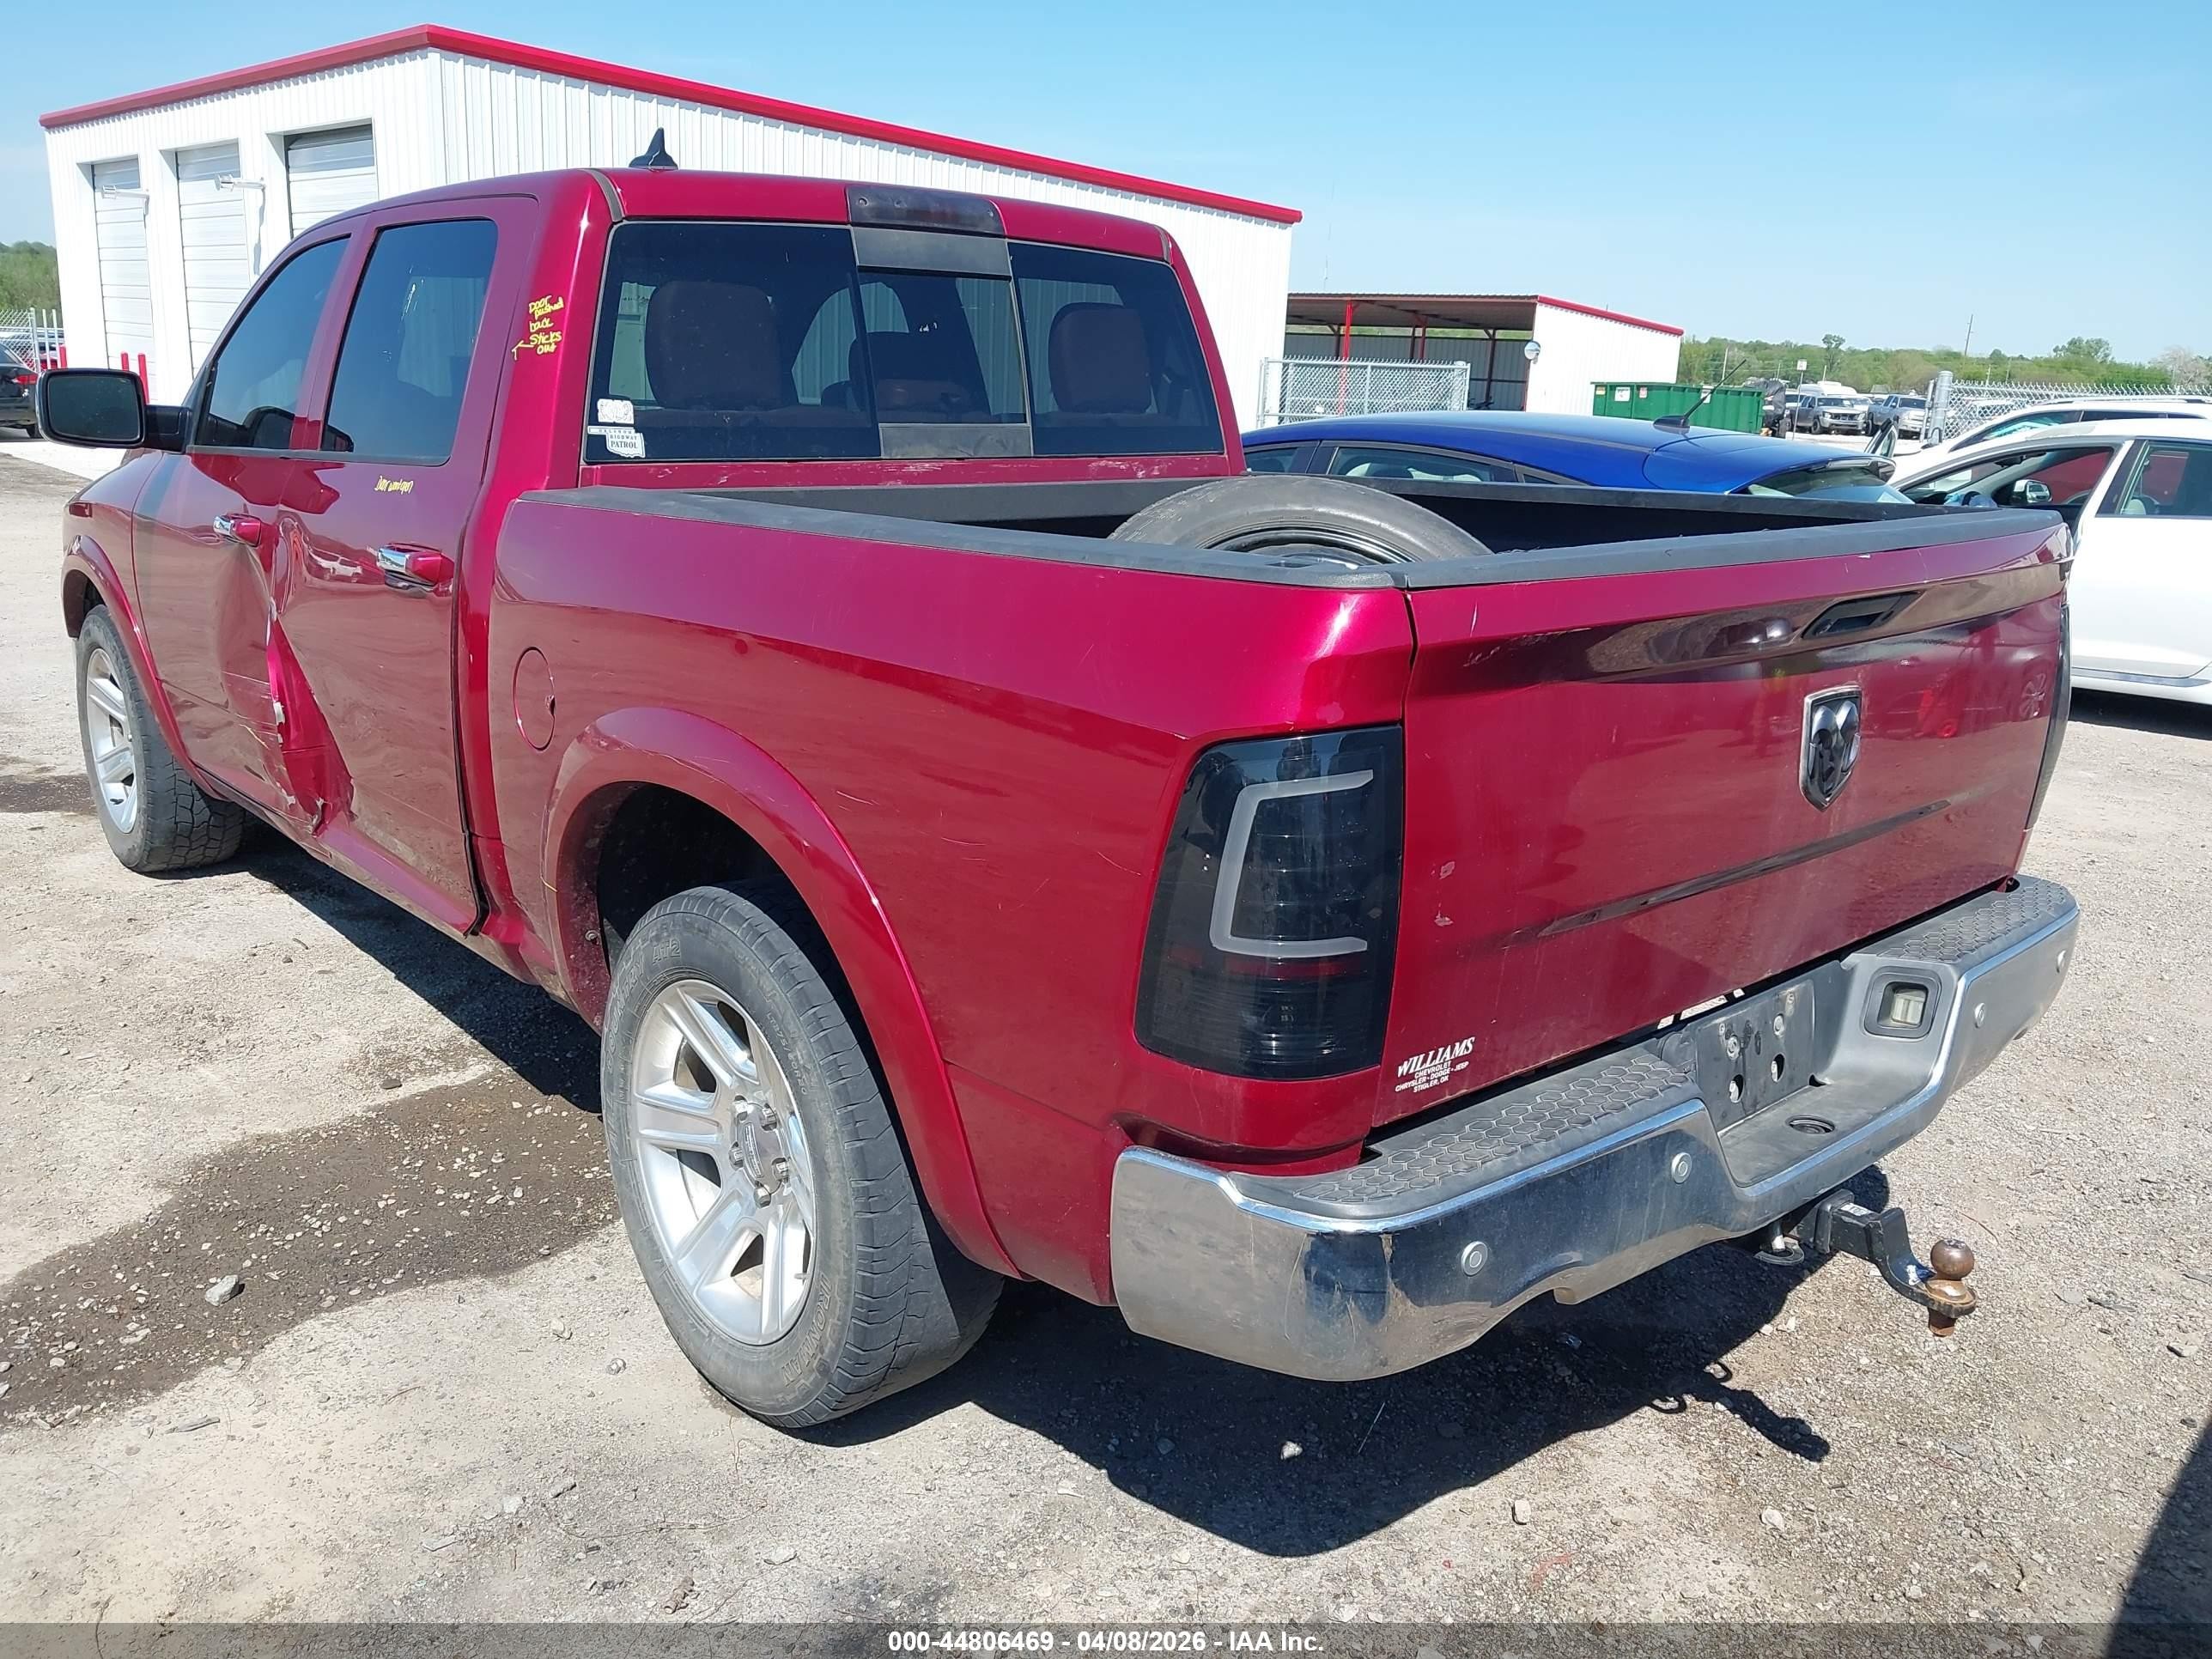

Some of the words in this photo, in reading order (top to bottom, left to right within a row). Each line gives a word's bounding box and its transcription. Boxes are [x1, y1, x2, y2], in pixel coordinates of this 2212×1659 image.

[534, 296, 564, 319] pushed
[529, 317, 554, 332] back
[611, 441, 639, 449] PATROL
[653, 938, 682, 965] AT2
[1397, 1036, 1475, 1078] WILLIAMS
[1395, 1074, 1427, 1092] CHRYSLER
[1430, 1067, 1451, 1080] DODGE
[1414, 1060, 1451, 1079] CHEVROLET
[1413, 1080, 1439, 1093] STIGLER,
[1440, 1074, 1449, 1083] OK
[782, 1272, 833, 1388] IRONMAN
